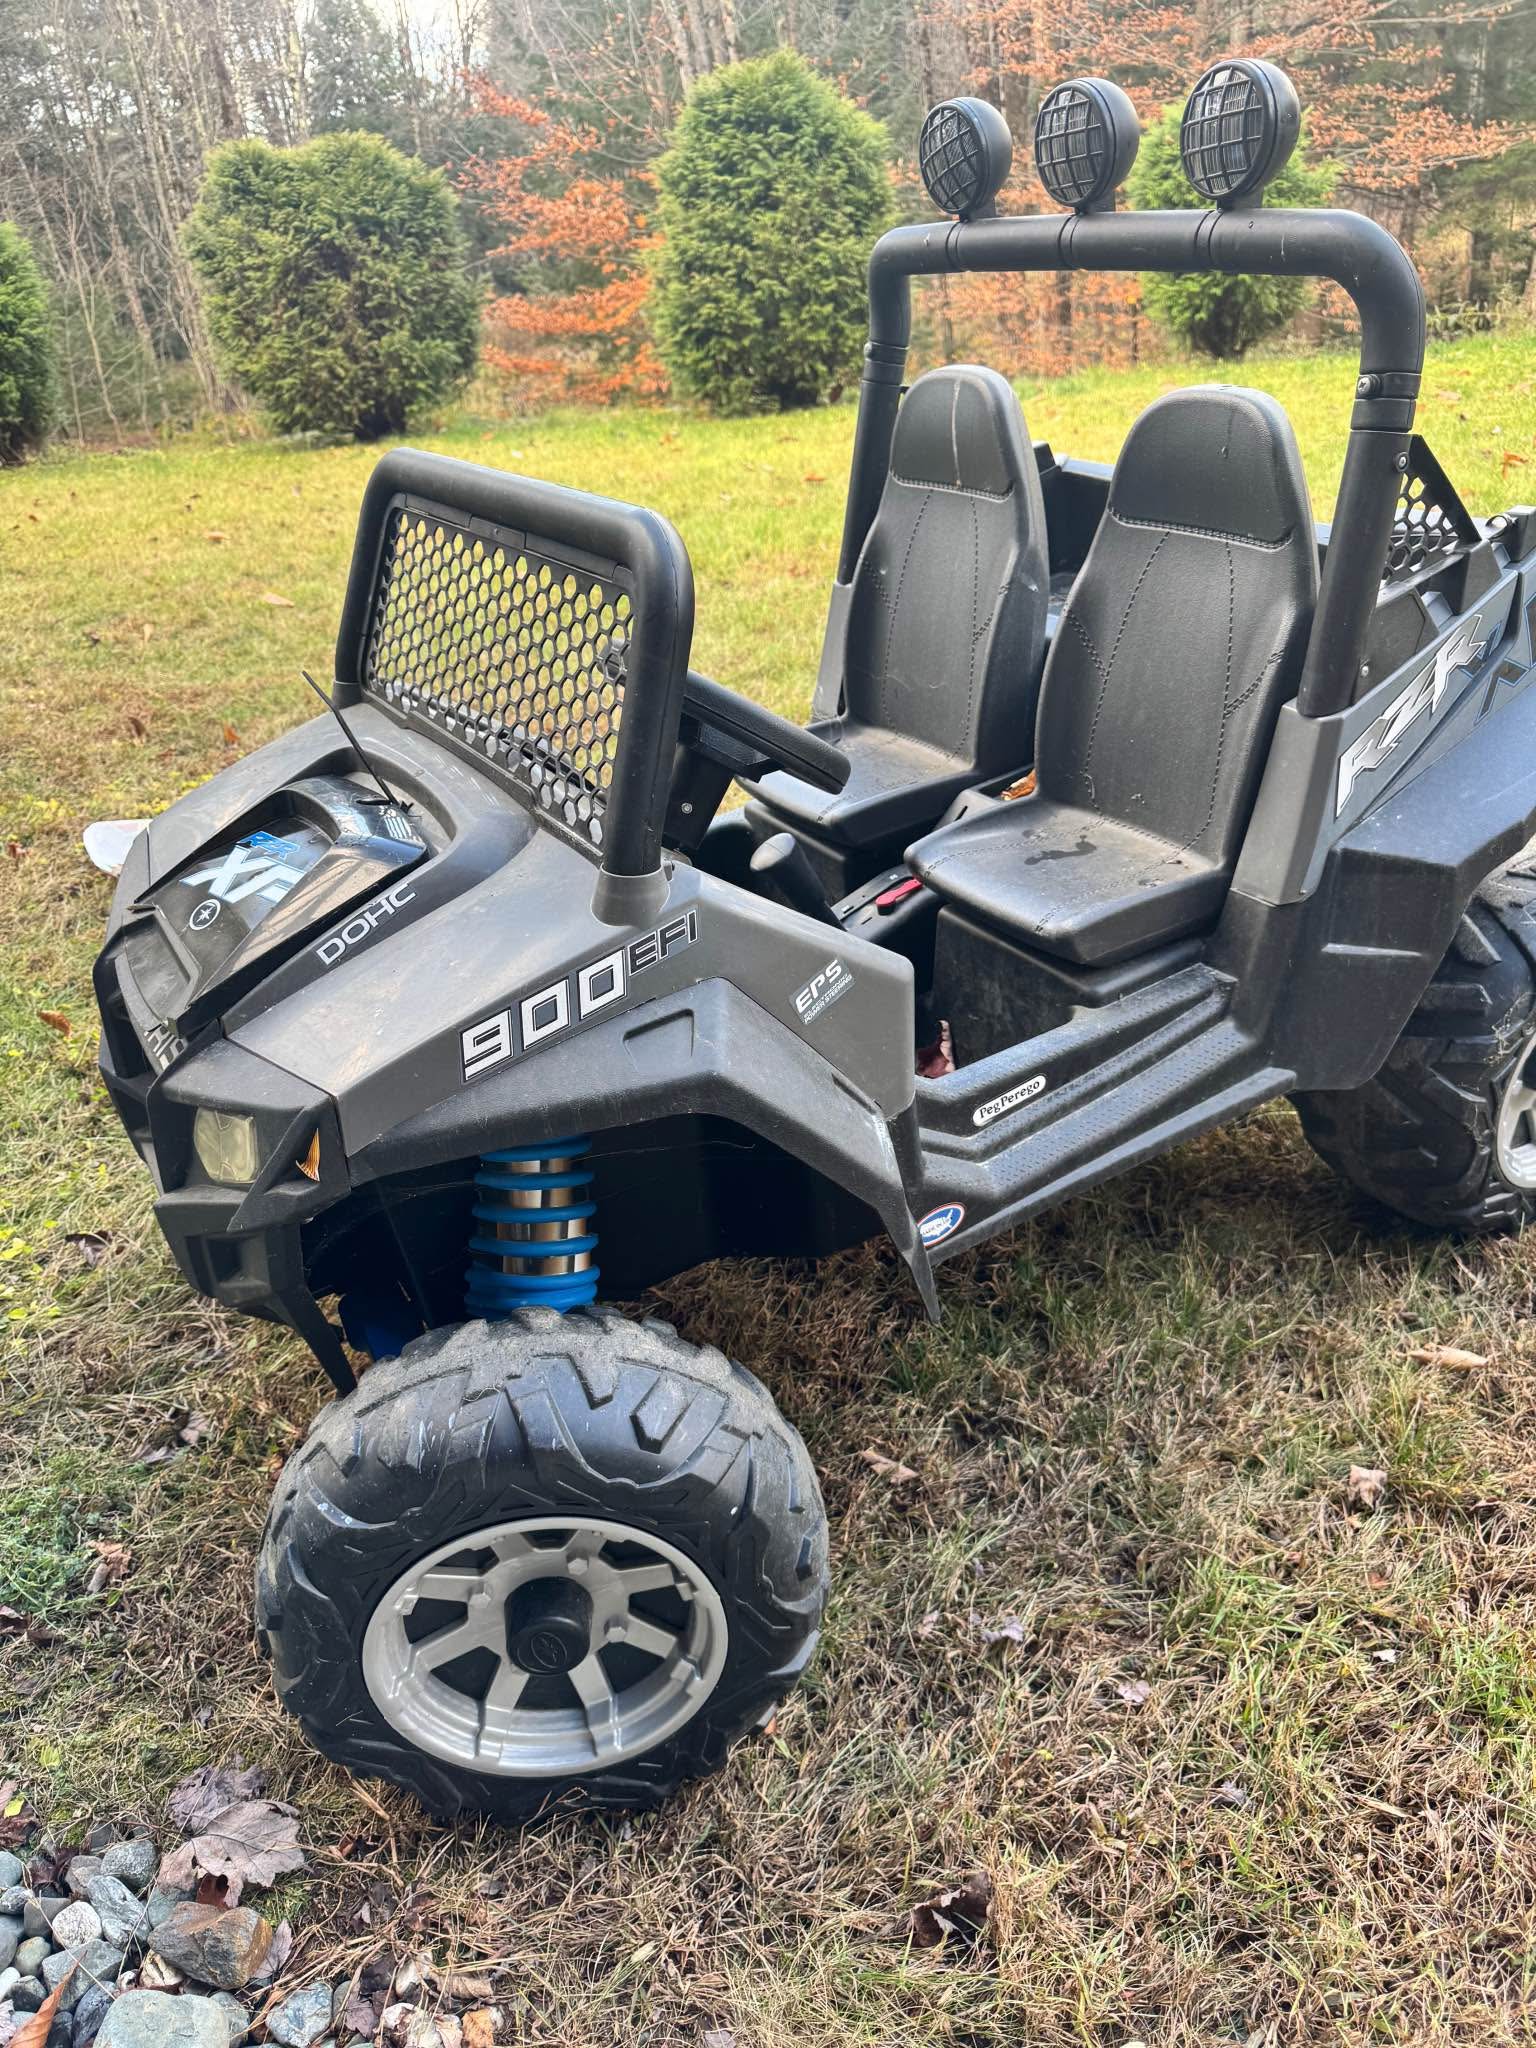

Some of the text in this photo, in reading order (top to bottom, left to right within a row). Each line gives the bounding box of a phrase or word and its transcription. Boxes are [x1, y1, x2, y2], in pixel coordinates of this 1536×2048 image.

[1335, 613, 1487, 819] RZR
[315, 883, 417, 966] DOHC
[795, 958, 843, 1014] EPS
[461, 906, 700, 1083] 900 EFI
